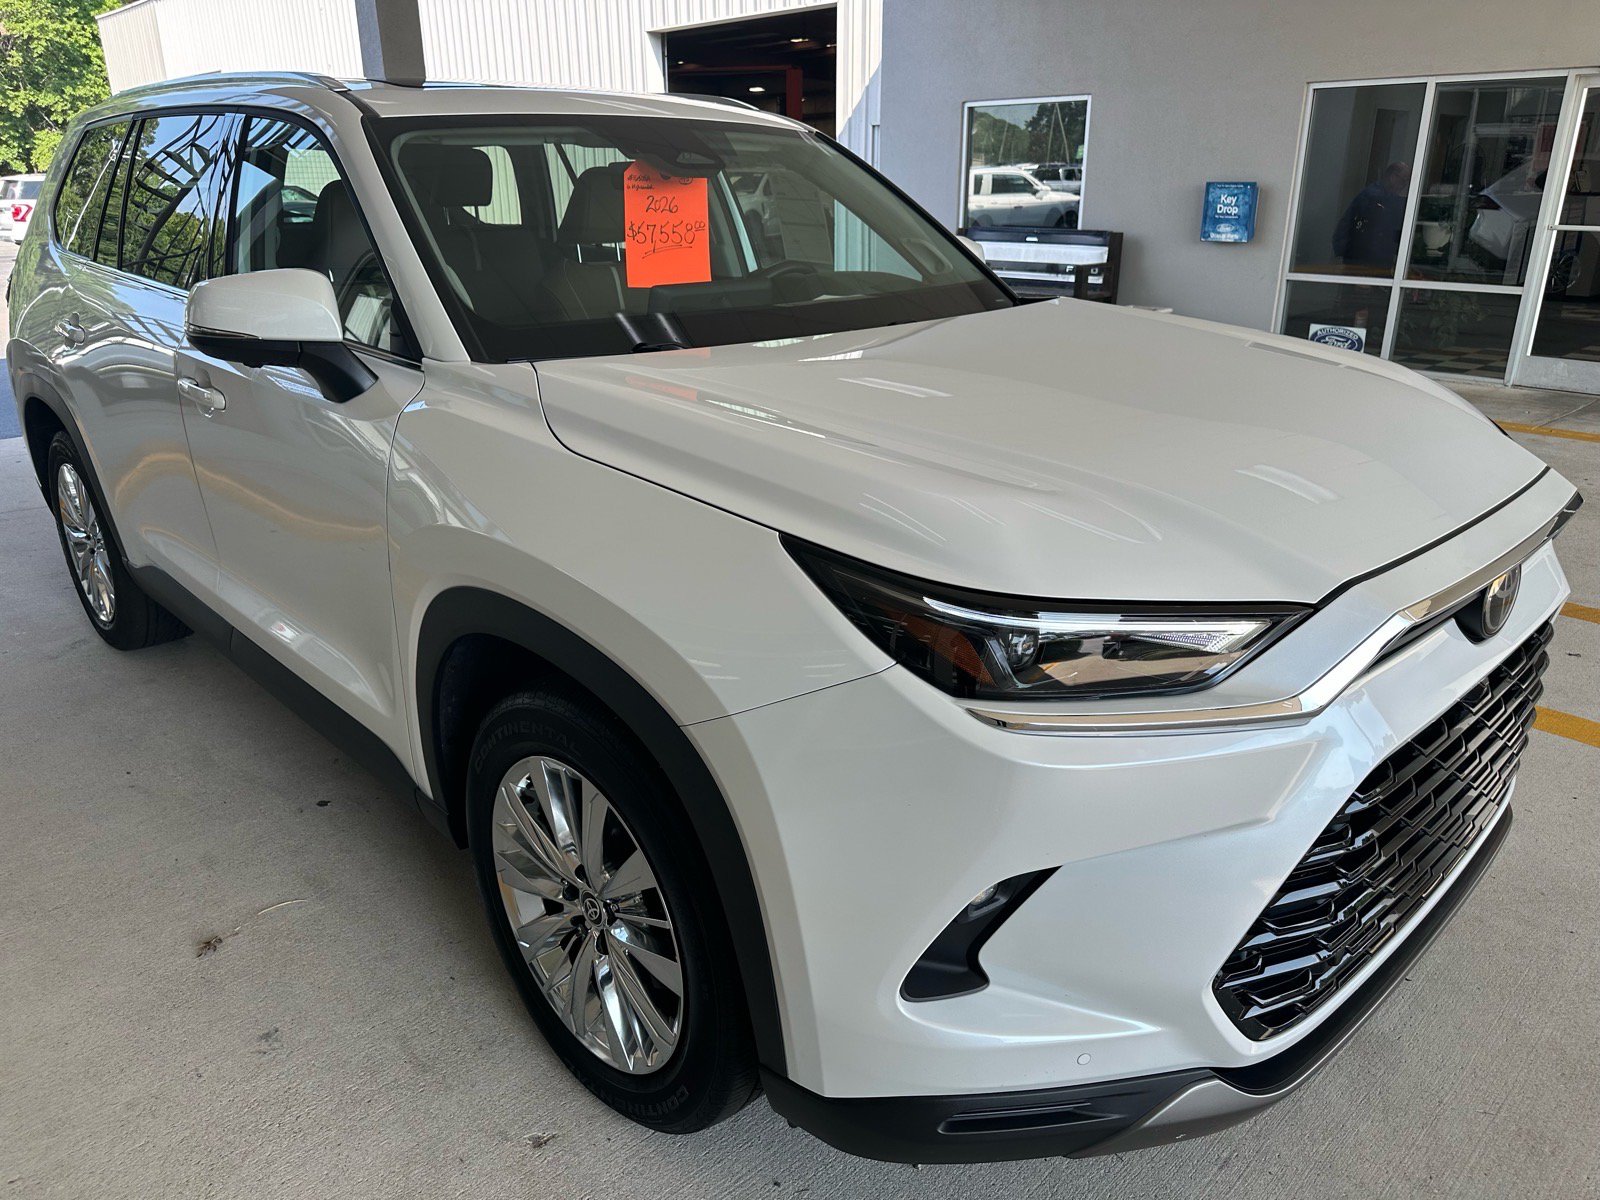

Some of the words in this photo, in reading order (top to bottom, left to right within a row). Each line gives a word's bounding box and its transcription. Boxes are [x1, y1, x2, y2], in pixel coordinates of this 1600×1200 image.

[645, 195, 679, 213] 2026
[1220, 194, 1237, 206] Key
[1217, 204, 1239, 215] Drop
[1317, 328, 1358, 340] AUTHORIZED
[474, 720, 581, 774] CONTINENTAL
